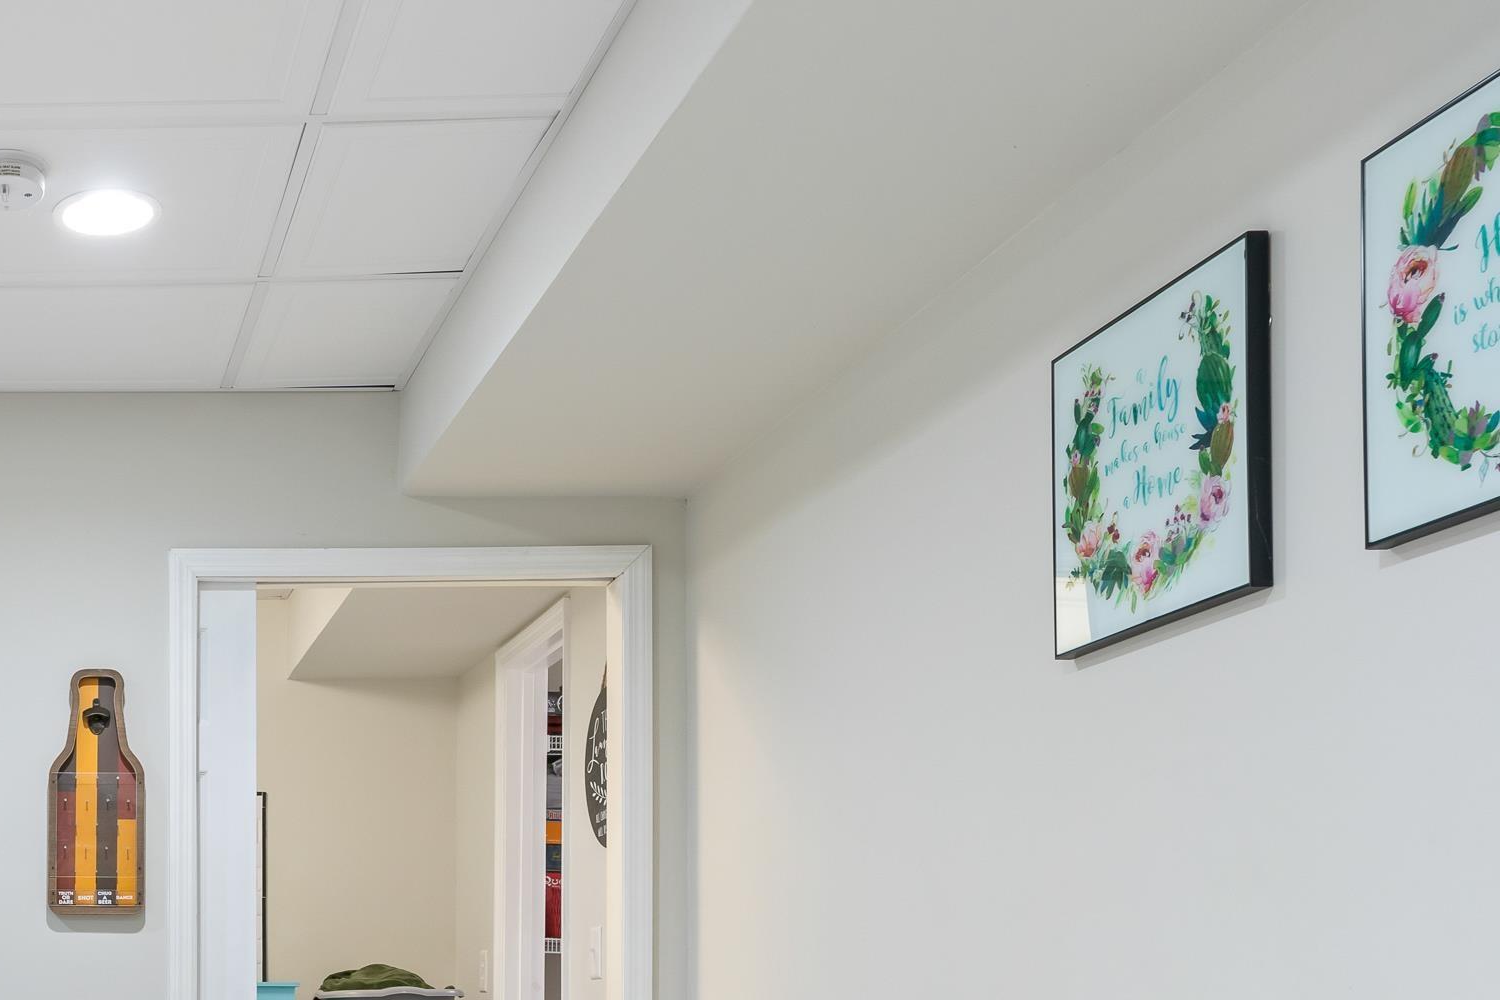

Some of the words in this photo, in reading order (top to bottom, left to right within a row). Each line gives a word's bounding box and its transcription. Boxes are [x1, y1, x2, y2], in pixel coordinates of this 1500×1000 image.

[1475, 212, 1500, 273] H
[1454, 303, 1468, 326] is
[1474, 277, 1500, 311] wh
[1472, 323, 1500, 353] sto
[1107, 355, 1180, 439] Family
[1105, 440, 1139, 476] makes
[1142, 442, 1150, 453] a
[1153, 422, 1185, 450] house
[1134, 465, 1181, 506] Home
